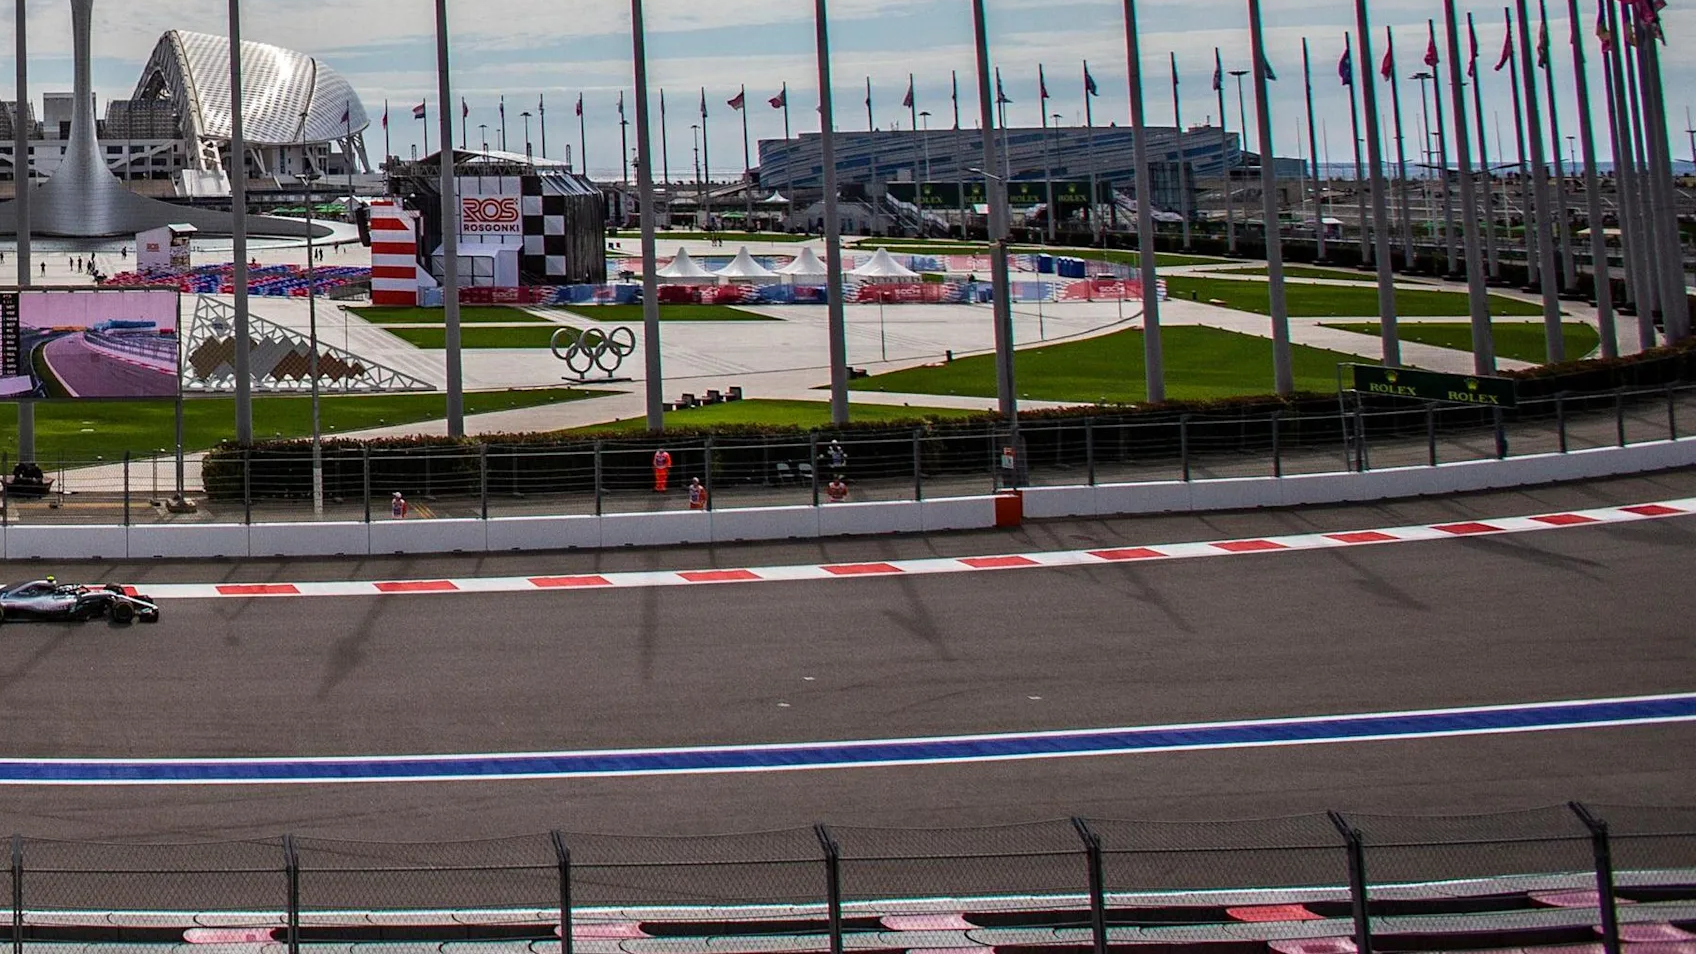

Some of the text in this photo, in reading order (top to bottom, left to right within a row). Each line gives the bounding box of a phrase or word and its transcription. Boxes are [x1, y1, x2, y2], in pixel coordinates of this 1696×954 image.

[463, 198, 518, 222] ROS
[463, 224, 520, 232] ROSGONKI
[1369, 382, 1417, 397] ROLEX
[1448, 390, 1500, 405] ROLEX
